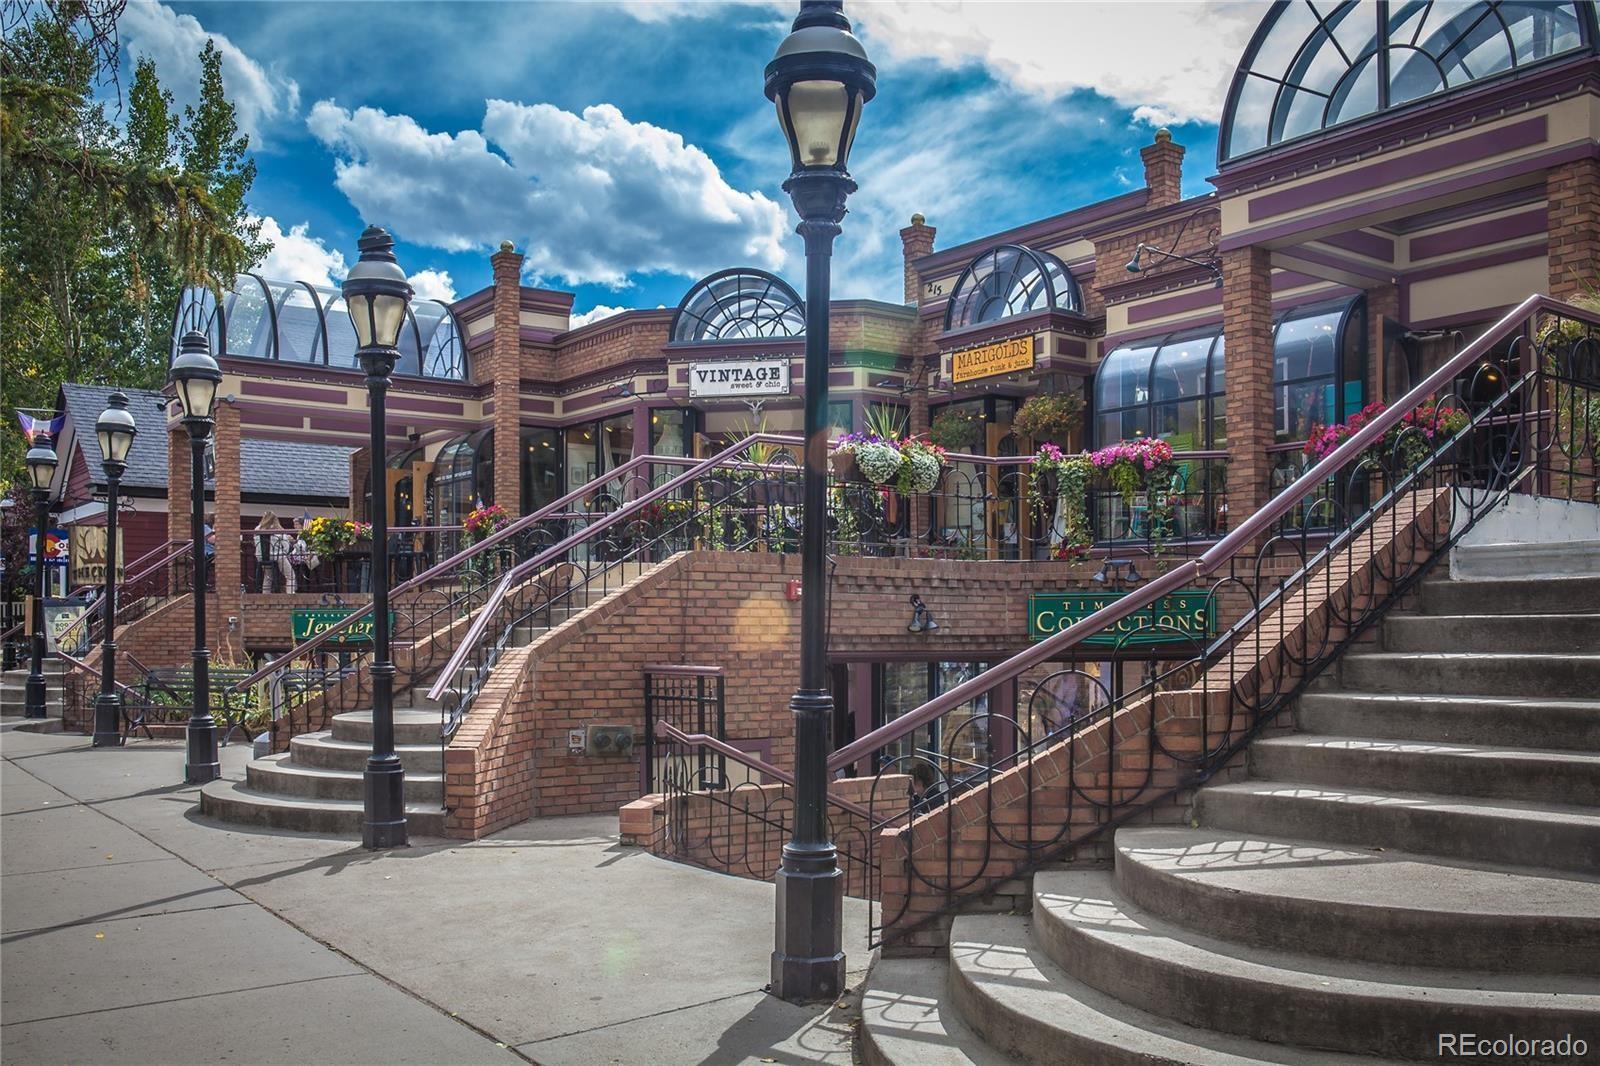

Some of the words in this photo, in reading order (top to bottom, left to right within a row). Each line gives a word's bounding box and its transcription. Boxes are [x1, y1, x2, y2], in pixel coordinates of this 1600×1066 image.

[927, 283, 942, 296] 215
[957, 340, 1028, 369] MARIGOLDS
[696, 367, 780, 383] VINTAGE
[91, 566, 124, 582] CRON
